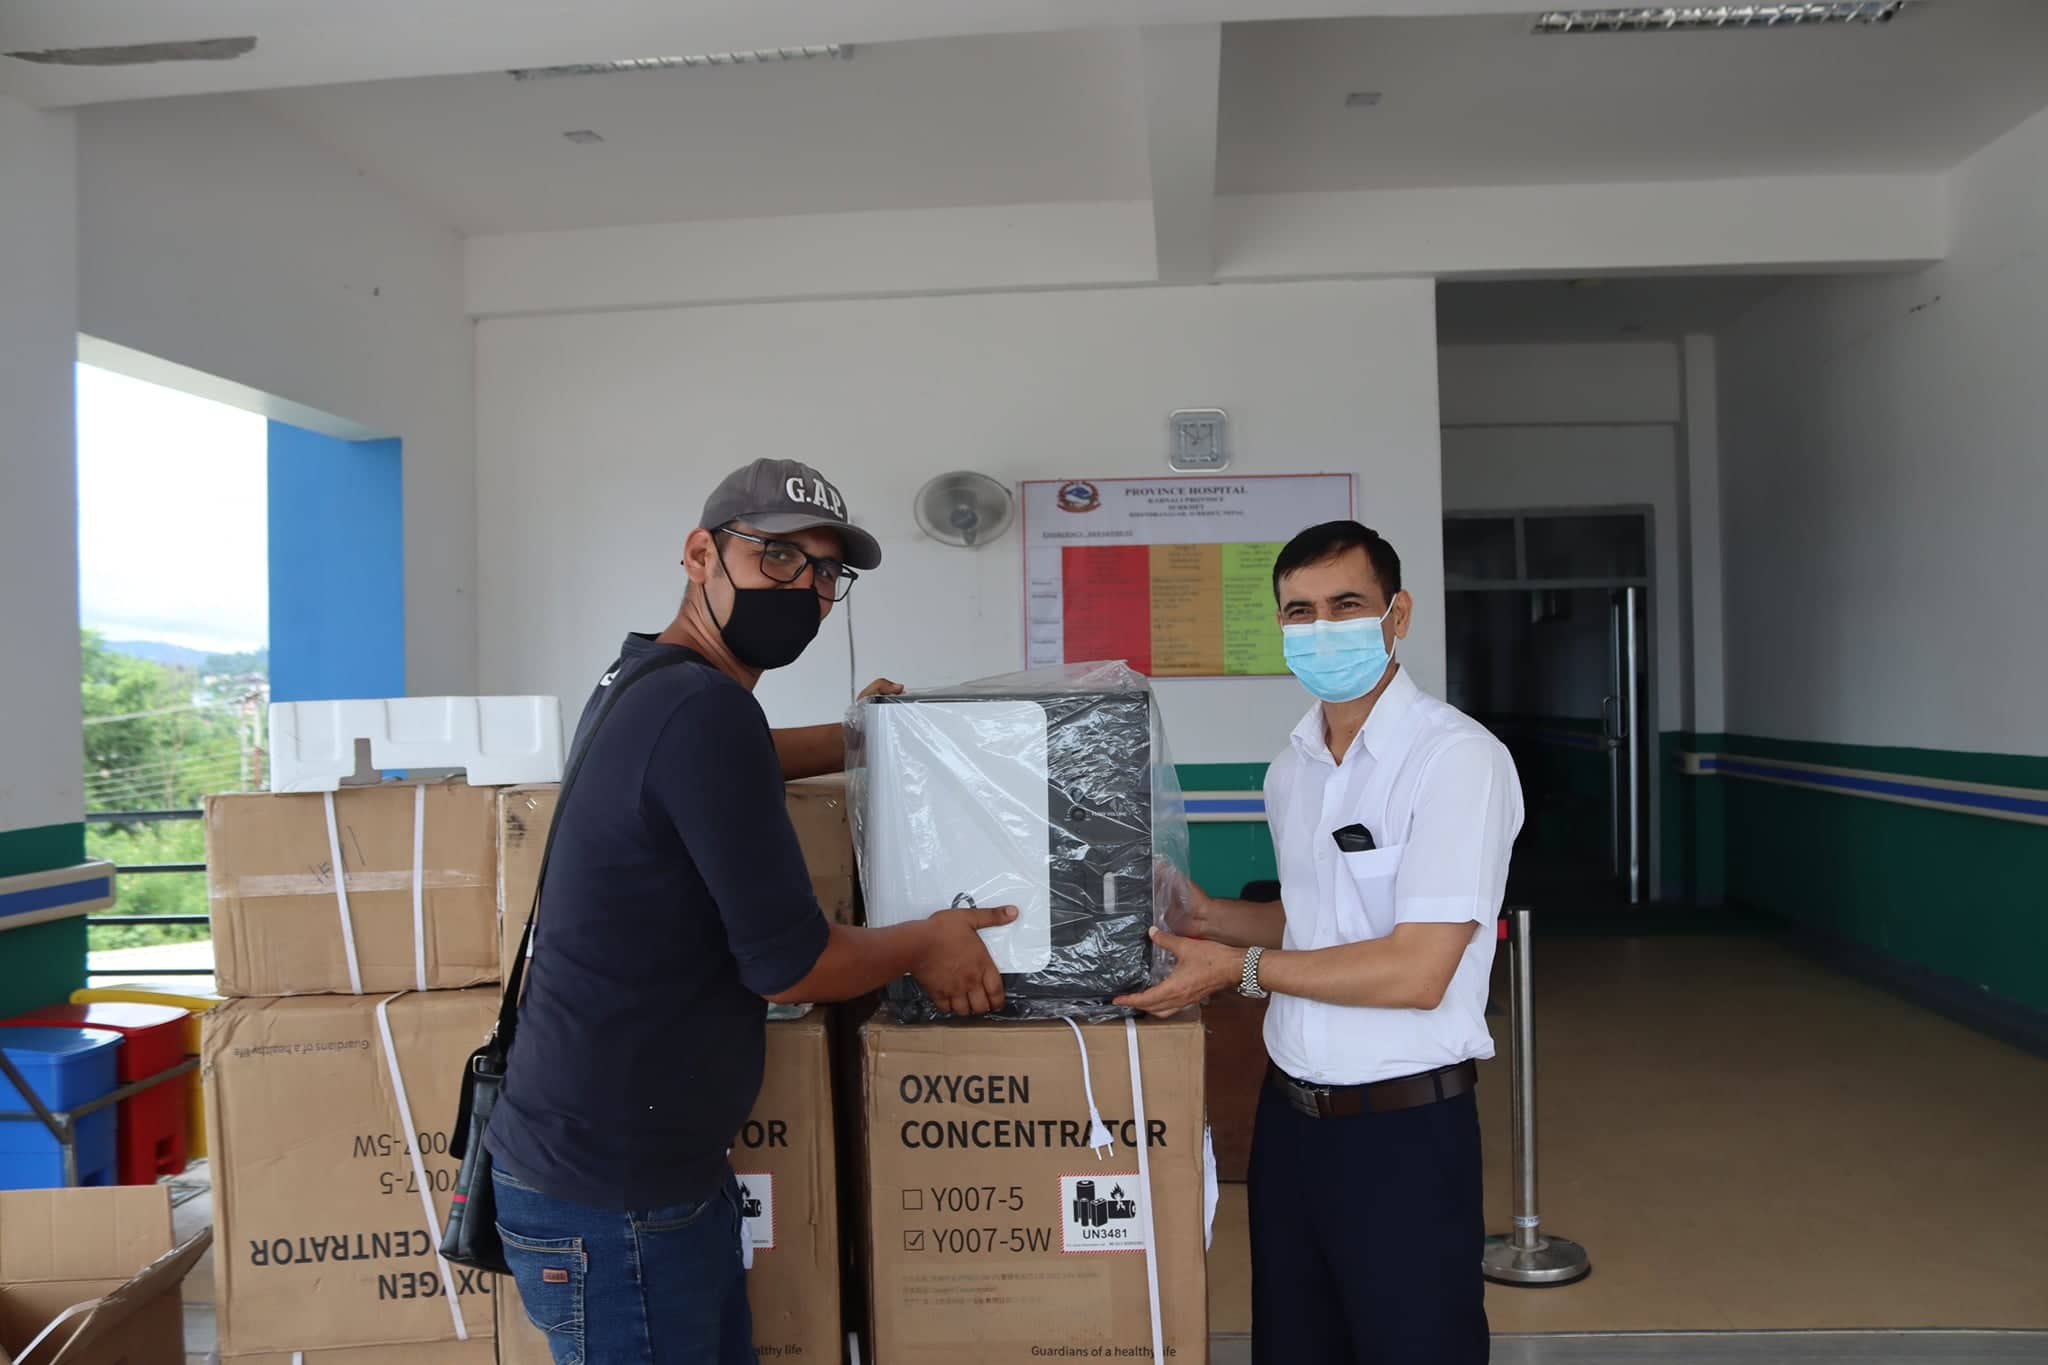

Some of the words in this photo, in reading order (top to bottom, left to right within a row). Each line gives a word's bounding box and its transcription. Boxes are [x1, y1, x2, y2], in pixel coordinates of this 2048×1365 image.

[1125, 487, 1184, 496] PROVINCE
[1188, 486, 1246, 495] HOSPITAL
[900, 1075, 1029, 1104] OXYGEN
[931, 1187, 1024, 1212] Y007-5
[932, 1228, 1052, 1253] Y007-5W
[1082, 1228, 1128, 1239] UN3481
[378, 1269, 491, 1301] OXGEN
[1031, 1346, 1088, 1356] Guardians
[1091, 1345, 1102, 1356] of
[1105, 1348, 1111, 1356] a
